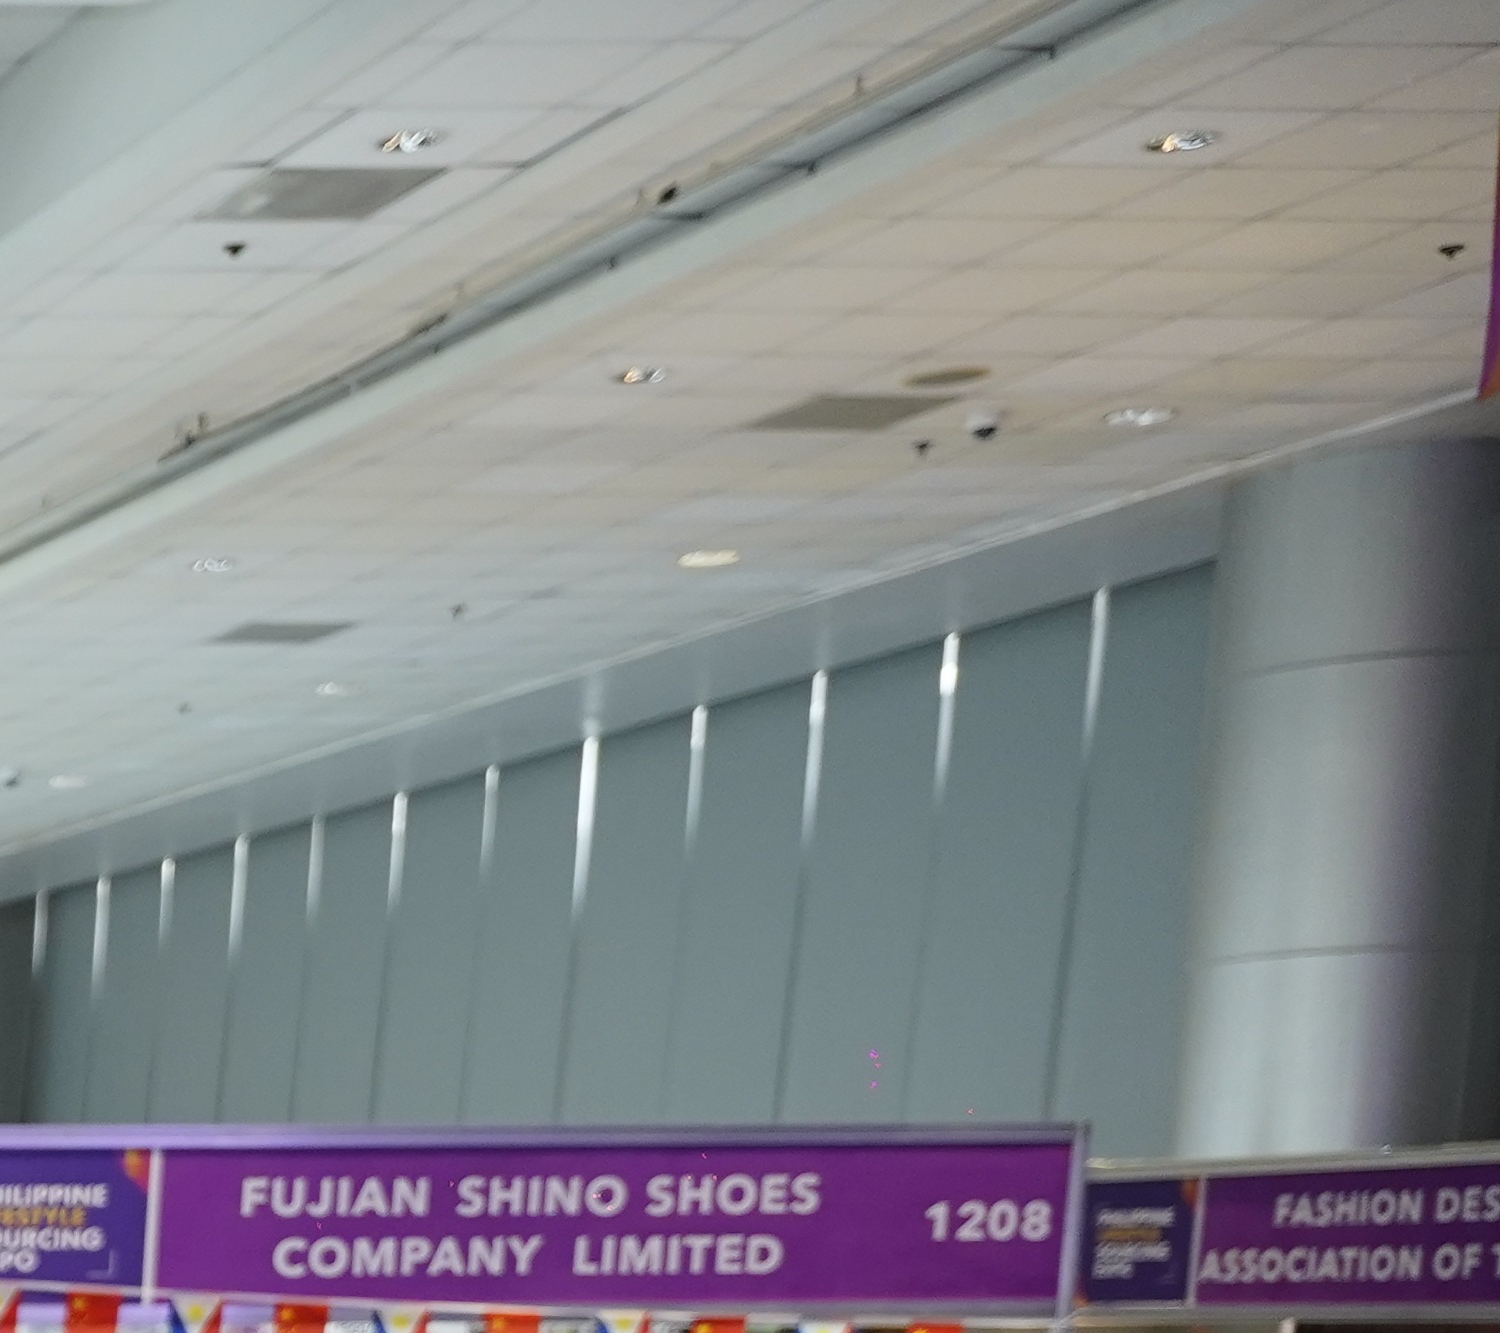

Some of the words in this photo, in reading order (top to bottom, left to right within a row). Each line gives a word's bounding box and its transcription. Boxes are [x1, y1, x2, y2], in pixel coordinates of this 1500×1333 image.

[239, 1175, 432, 1219] FUJIAN
[455, 1174, 628, 1218] SHINO
[645, 1172, 822, 1217] SHOES
[1272, 1187, 1424, 1229] FASHION
[925, 1199, 1052, 1243] 1208
[271, 1235, 545, 1280] COMPANY
[571, 1233, 784, 1277] LIMITED
[1199, 1244, 1424, 1285] ASSOCIATION
[1432, 1242, 1483, 1281] OF
